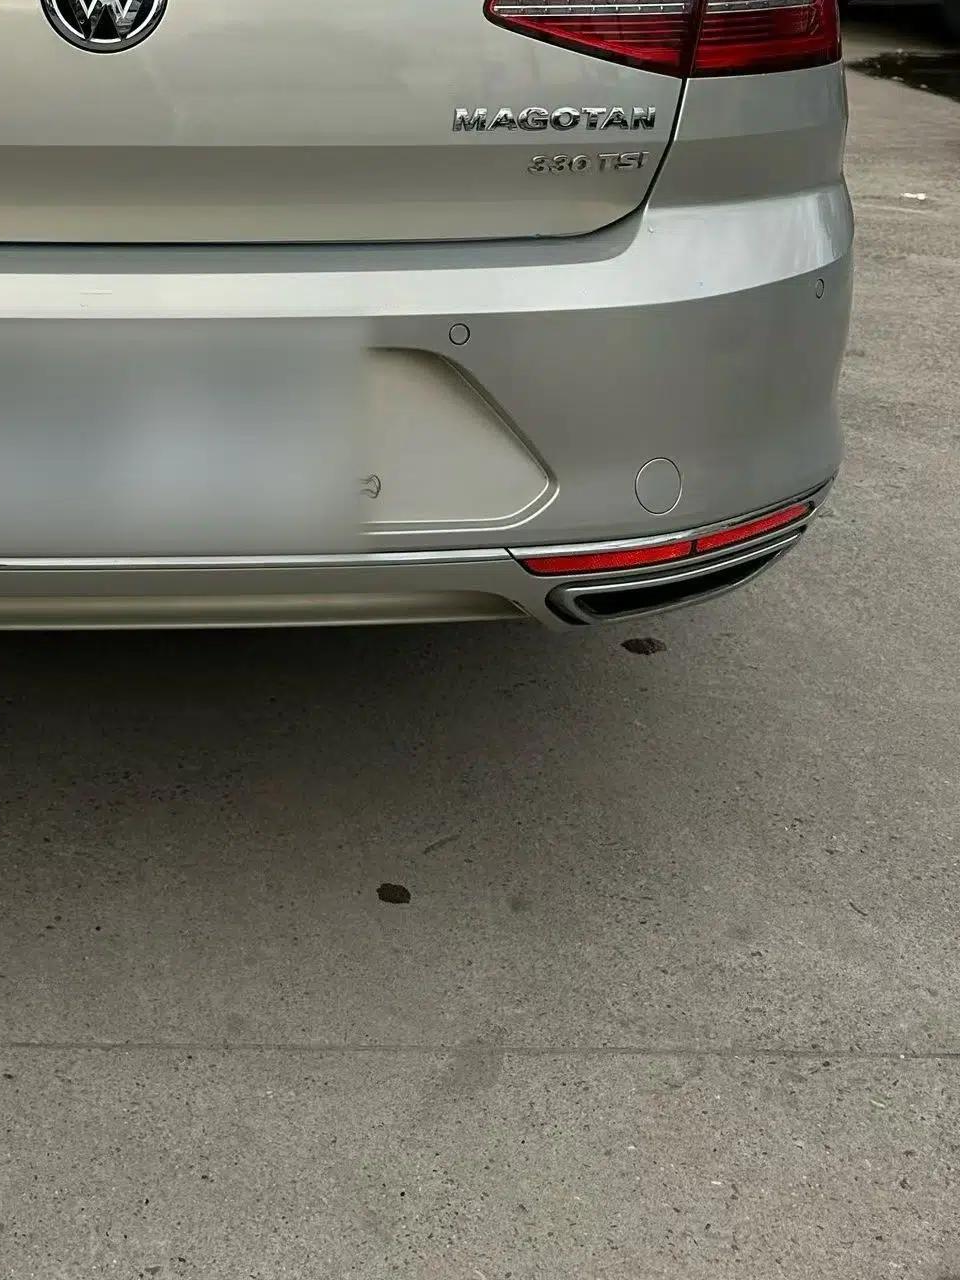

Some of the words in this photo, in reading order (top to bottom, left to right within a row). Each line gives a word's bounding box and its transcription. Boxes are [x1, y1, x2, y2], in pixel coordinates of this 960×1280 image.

[452, 106, 657, 132] MAGOTAN
[528, 154, 590, 175] 330
[598, 151, 650, 172] TSI
